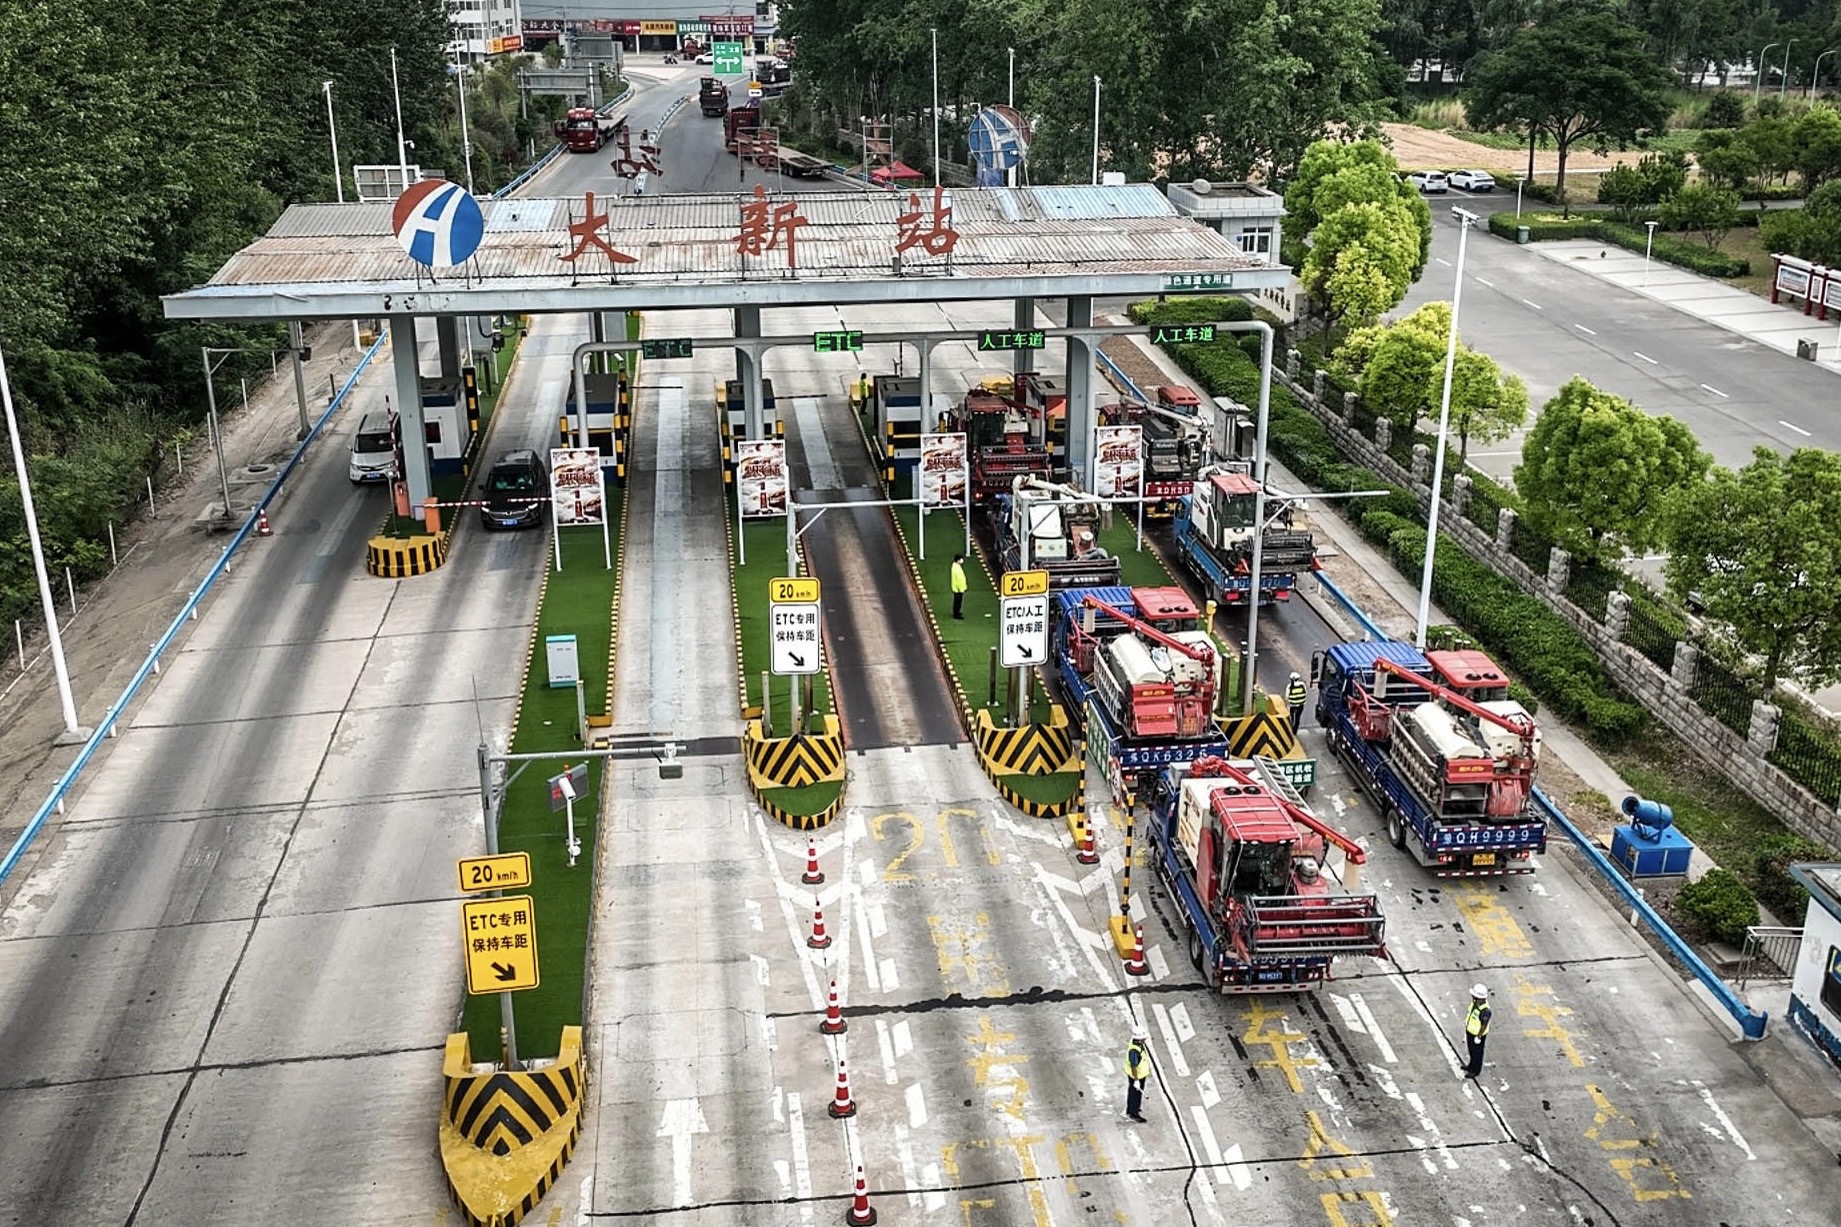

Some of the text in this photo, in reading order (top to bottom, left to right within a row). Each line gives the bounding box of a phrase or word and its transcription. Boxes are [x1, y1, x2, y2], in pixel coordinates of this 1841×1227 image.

[557, 182, 959, 268] 大新站
[814, 331, 864, 352] ETC
[980, 330, 1045, 351] 人工车道
[1153, 326, 1216, 345] 人工车道
[643, 339, 691, 358] ETC
[779, 583, 794, 599] 20
[1010, 577, 1024, 592] 20
[775, 613, 815, 625] ETC专用
[1006, 605, 1043, 619] ETC/人工
[776, 629, 815, 642] 保持车距
[1006, 621, 1043, 635] 保持车距
[471, 864, 518, 884] 20 km/h
[470, 910, 527, 931] ETC专用
[472, 933, 529, 953] 保持车距
